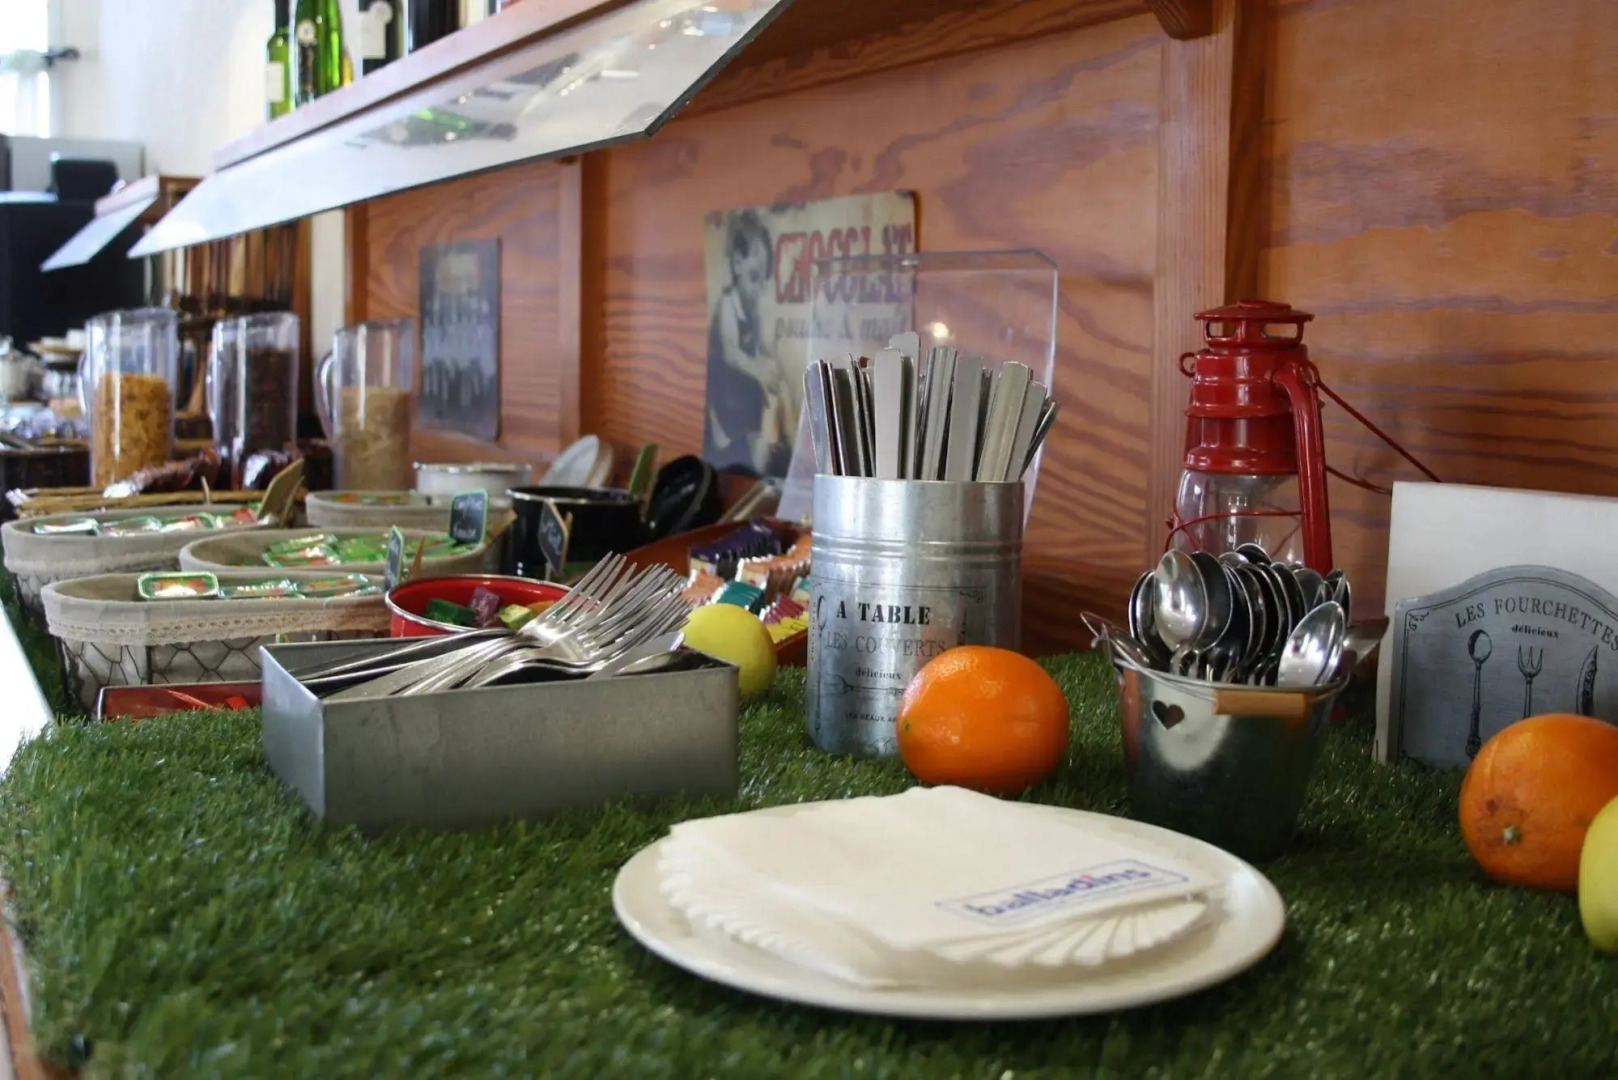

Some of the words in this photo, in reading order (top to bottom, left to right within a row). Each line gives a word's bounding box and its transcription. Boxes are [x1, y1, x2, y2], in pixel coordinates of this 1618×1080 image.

[836, 600, 847, 619] A
[858, 602, 931, 626] TABLE
[1455, 602, 1486, 629] LES
[1494, 595, 1618, 652] FOURCHETTES
[1512, 624, 1560, 639] délicieux
[826, 631, 848, 651] LES
[855, 666, 902, 680] délicieux
